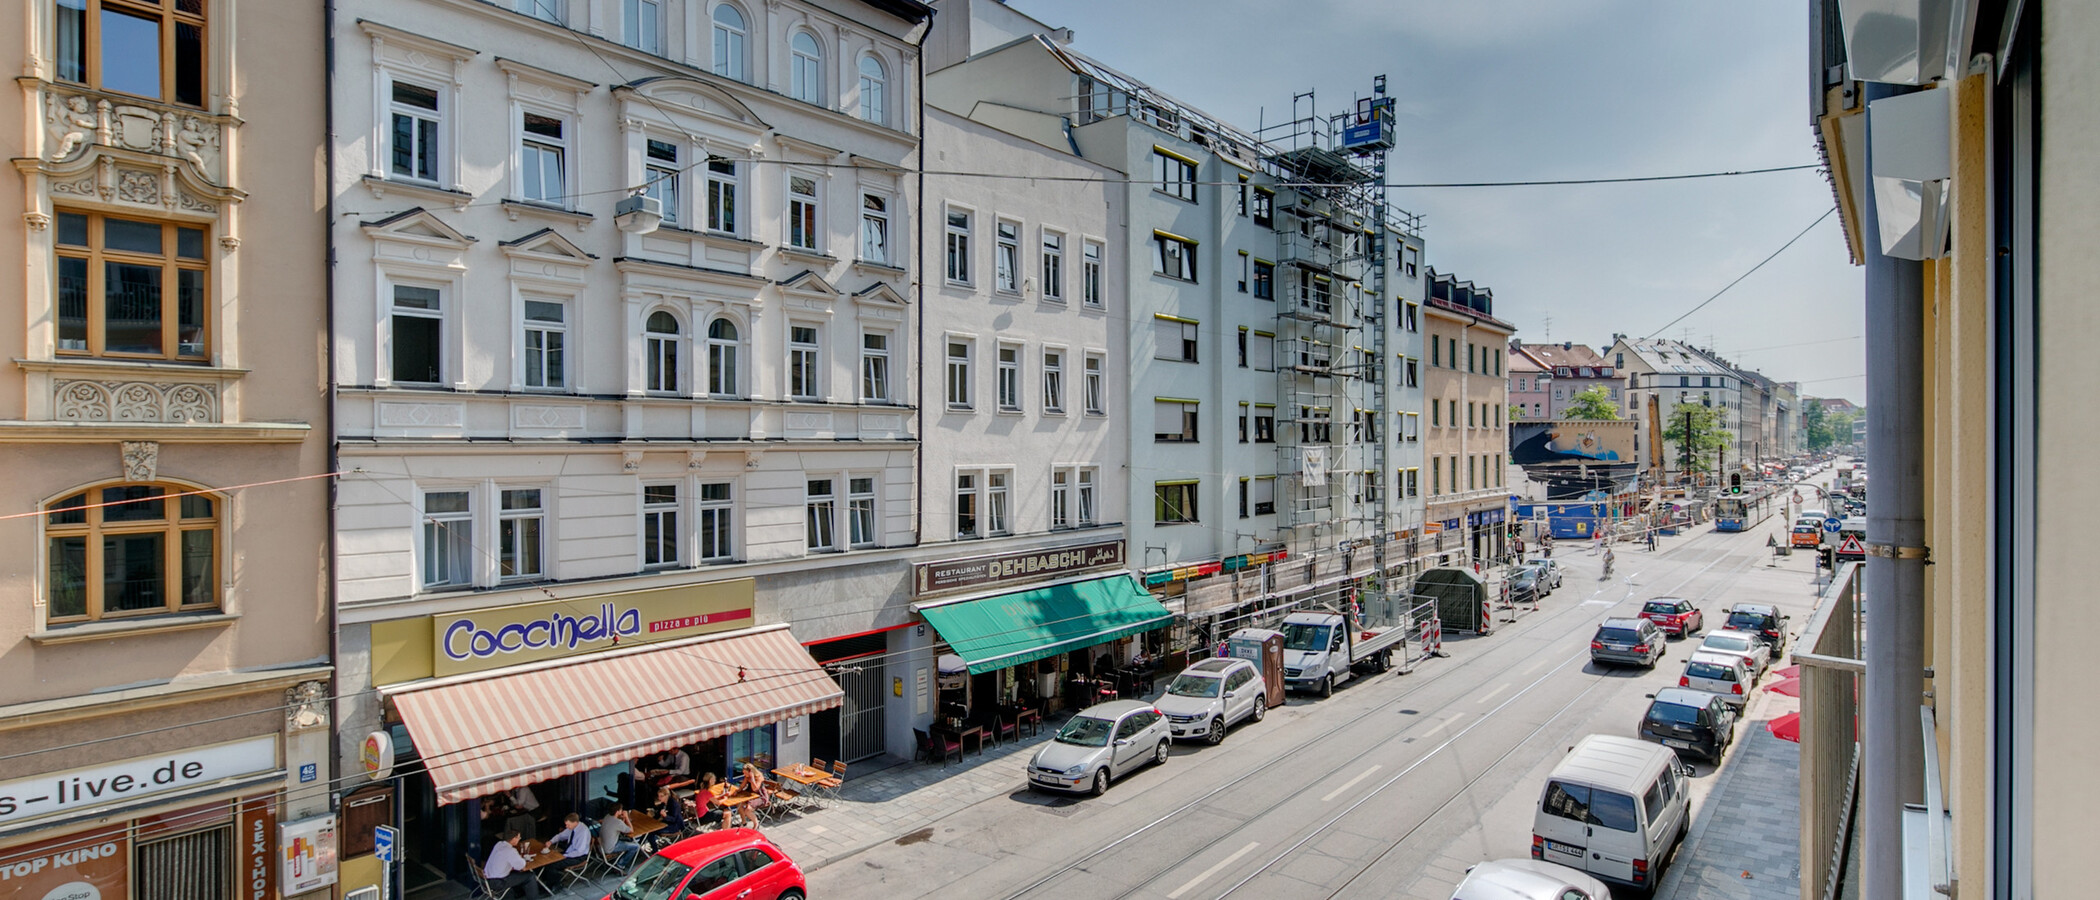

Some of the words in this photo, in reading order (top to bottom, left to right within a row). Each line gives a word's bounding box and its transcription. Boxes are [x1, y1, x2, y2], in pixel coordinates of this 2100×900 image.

[935, 565, 986, 578] RESTAURANT
[989, 550, 1086, 578] DEHBASCHI
[443, 603, 640, 659] Coccinella
[654, 619, 680, 632] pizza
[684, 618, 690, 626] e
[302, 765, 315, 775] 42
[252, 819, 267, 855] SEX
[53, 842, 118, 869] KINO
[252, 856, 267, 900] SHOP
